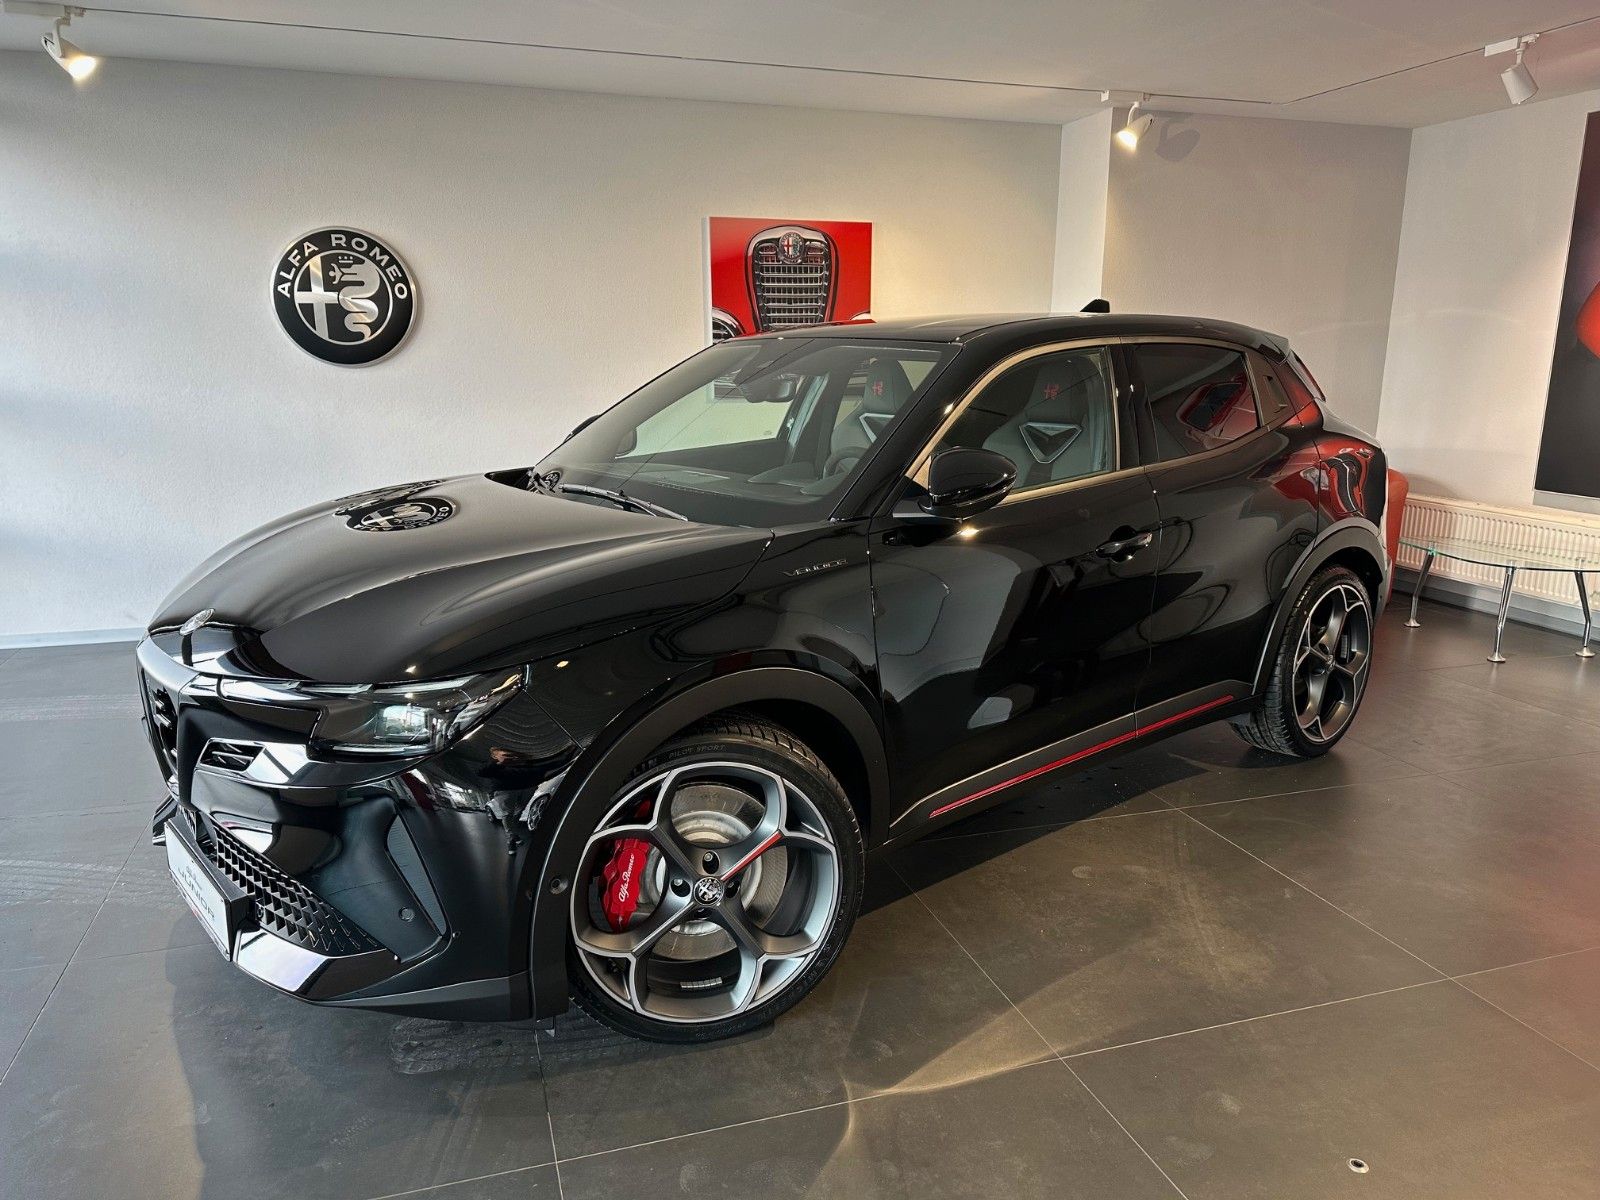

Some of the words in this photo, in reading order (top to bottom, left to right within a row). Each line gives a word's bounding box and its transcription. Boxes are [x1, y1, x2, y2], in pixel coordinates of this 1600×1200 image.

[277, 241, 319, 298] ALFA
[331, 234, 408, 299] ROMEO
[668, 747, 694, 758] PILOT
[696, 744, 726, 753] SPORT
[622, 853, 635, 882] Romeo
[618, 881, 630, 902] Alfa
